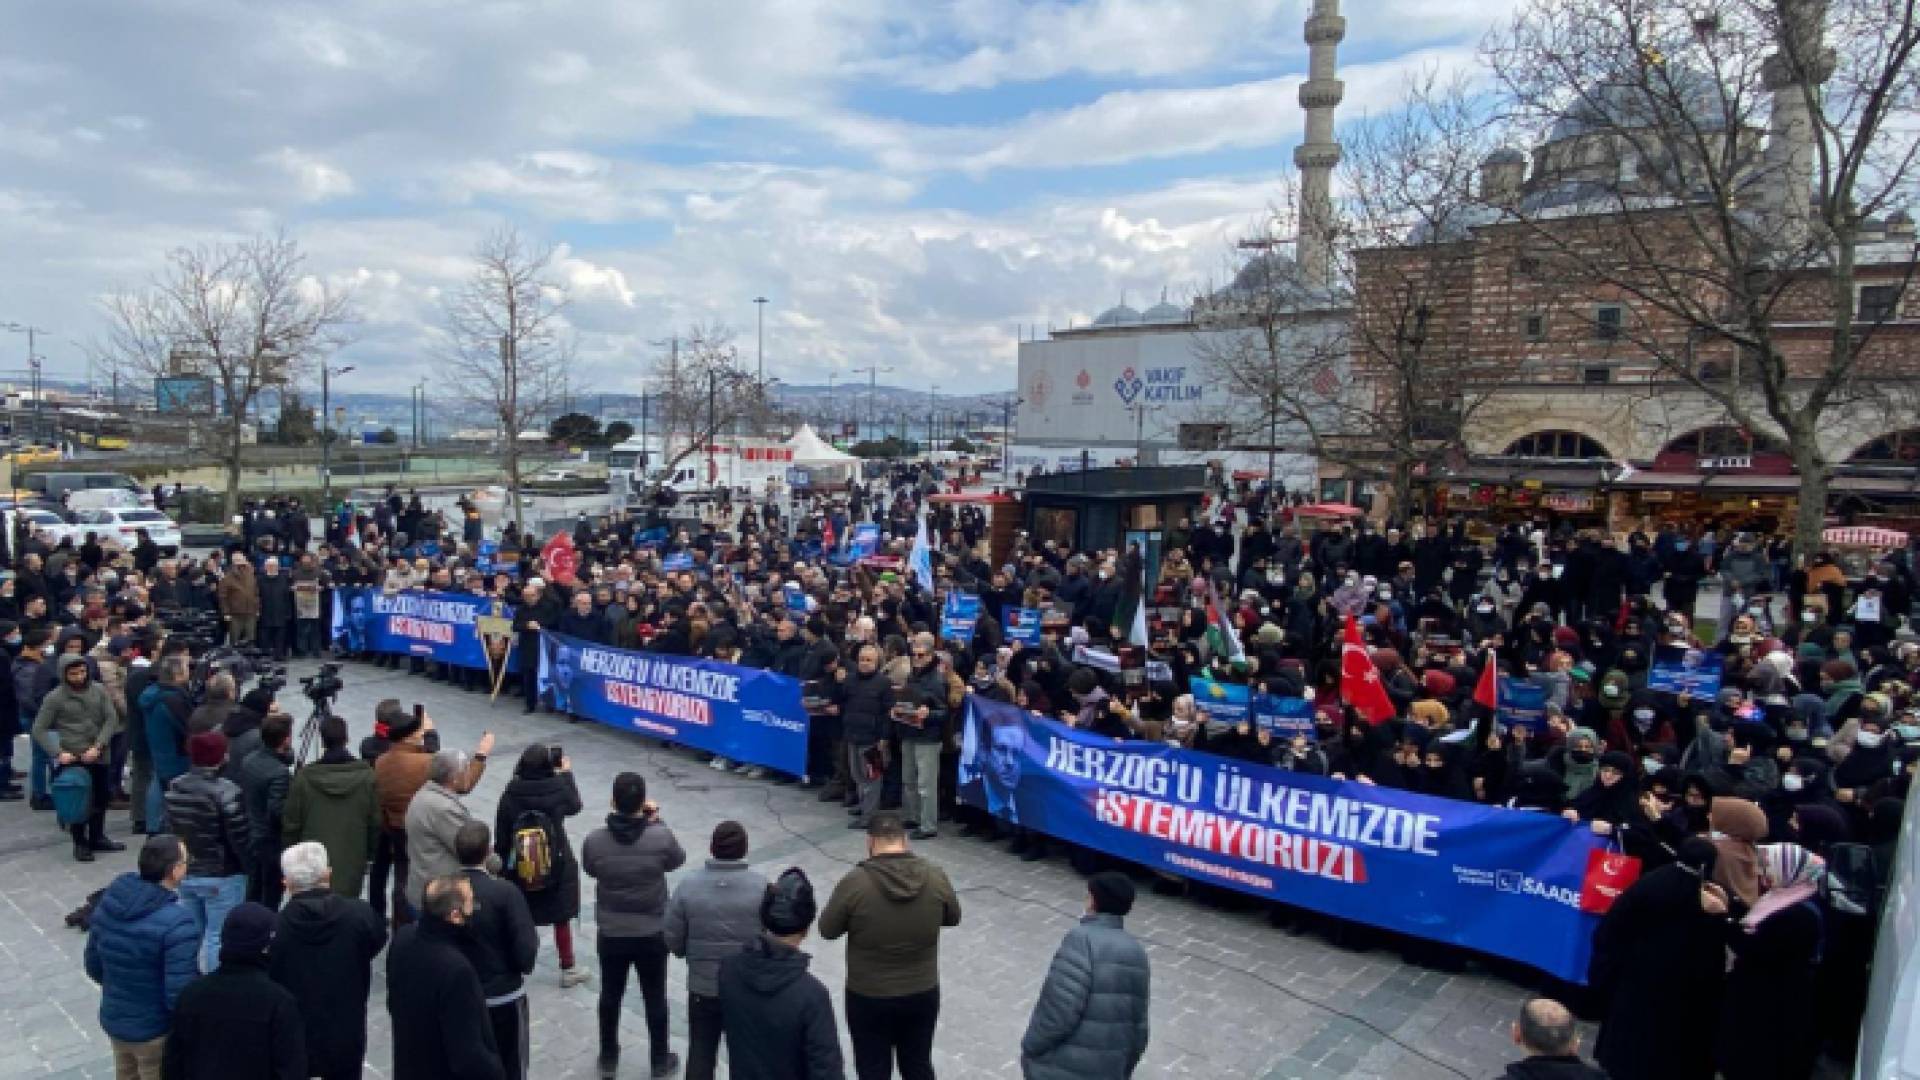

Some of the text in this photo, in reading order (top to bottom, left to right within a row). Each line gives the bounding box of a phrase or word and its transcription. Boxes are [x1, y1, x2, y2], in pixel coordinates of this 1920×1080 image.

[1145, 367, 1186, 384] VAKIF
[1145, 386, 1202, 401] KATILIM
[1045, 737, 1202, 802] HERZOG'U
